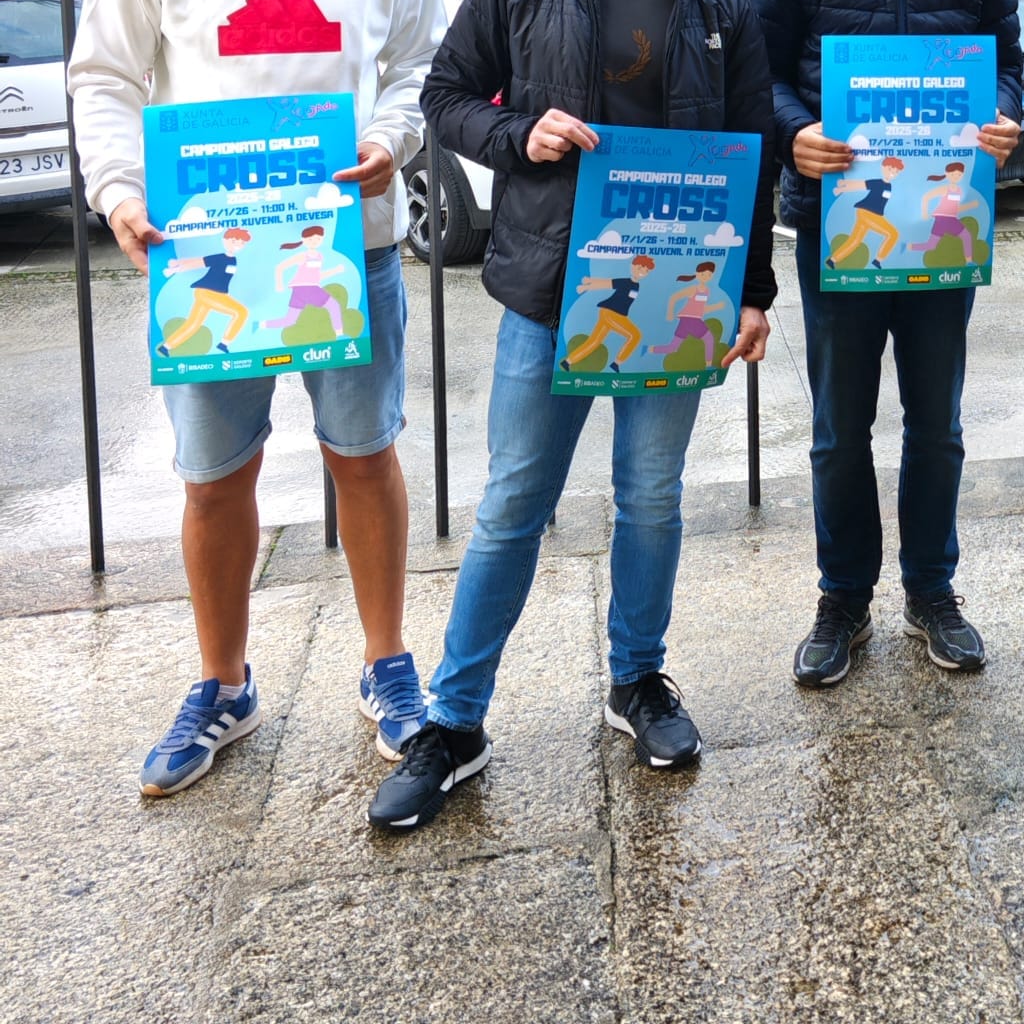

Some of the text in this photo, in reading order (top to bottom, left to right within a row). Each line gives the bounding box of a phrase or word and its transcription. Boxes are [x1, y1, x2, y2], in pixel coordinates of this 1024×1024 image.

[850, 76, 965, 89] CAMPIONATO GALEGO
[847, 89, 970, 124] CROSS
[180, 135, 320, 157] CAMPIONATO GALEGO
[868, 138, 903, 147] 17/1/26
[914, 138, 933, 146] 11:00
[850, 147, 973, 157] MPAMENTO XUVENIL A DEVESA
[31, 153, 64, 171] JSV
[176, 149, 327, 195] CROSS
[608, 169, 726, 186] CAMPIONATO GALEGO
[205, 206, 248, 218] 17/1/26
[261, 203, 285, 213] 11:00
[600, 182, 731, 222] CROSS
[168, 210, 334, 233] CAMPAMENTO XUVENIL A DEVESA
[620, 234, 657, 244] 17/1/26
[666, 236, 688, 245] 11:00
[586, 244, 726, 256] CAMPAMENTO XUVENIL A DEVESA
